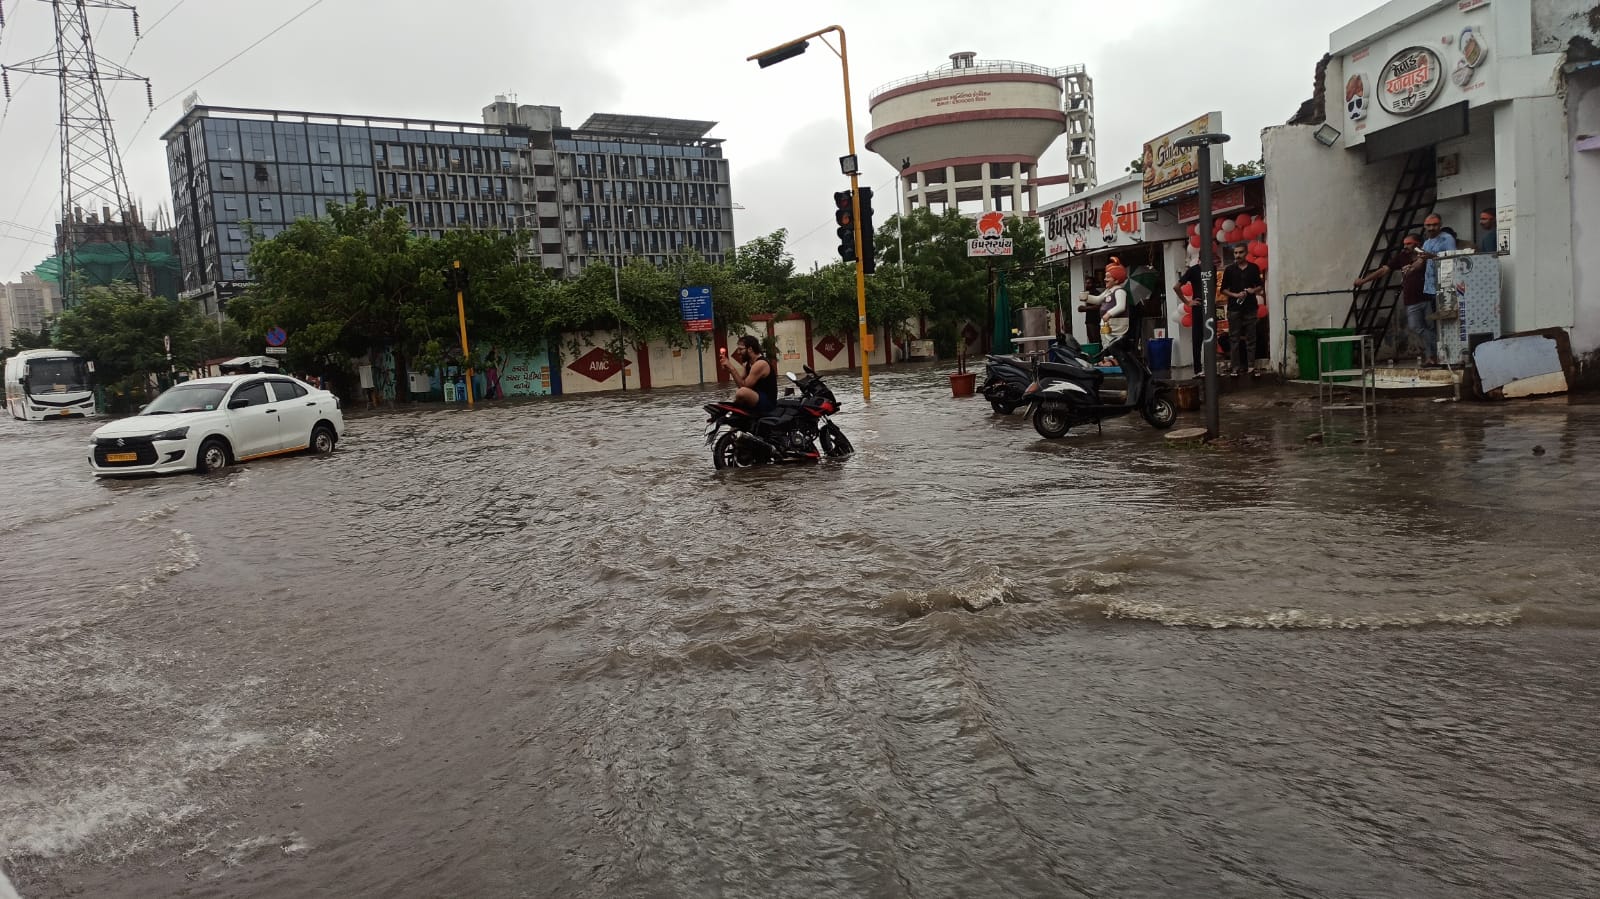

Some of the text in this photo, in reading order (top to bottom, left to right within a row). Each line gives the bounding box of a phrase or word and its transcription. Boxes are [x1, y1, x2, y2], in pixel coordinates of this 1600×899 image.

[1048, 203, 1098, 240] ઉપસરપંચ
[1117, 201, 1138, 233] ચા
[971, 239, 1011, 249] ઉપસરપંચ
[589, 360, 609, 371] AMC
